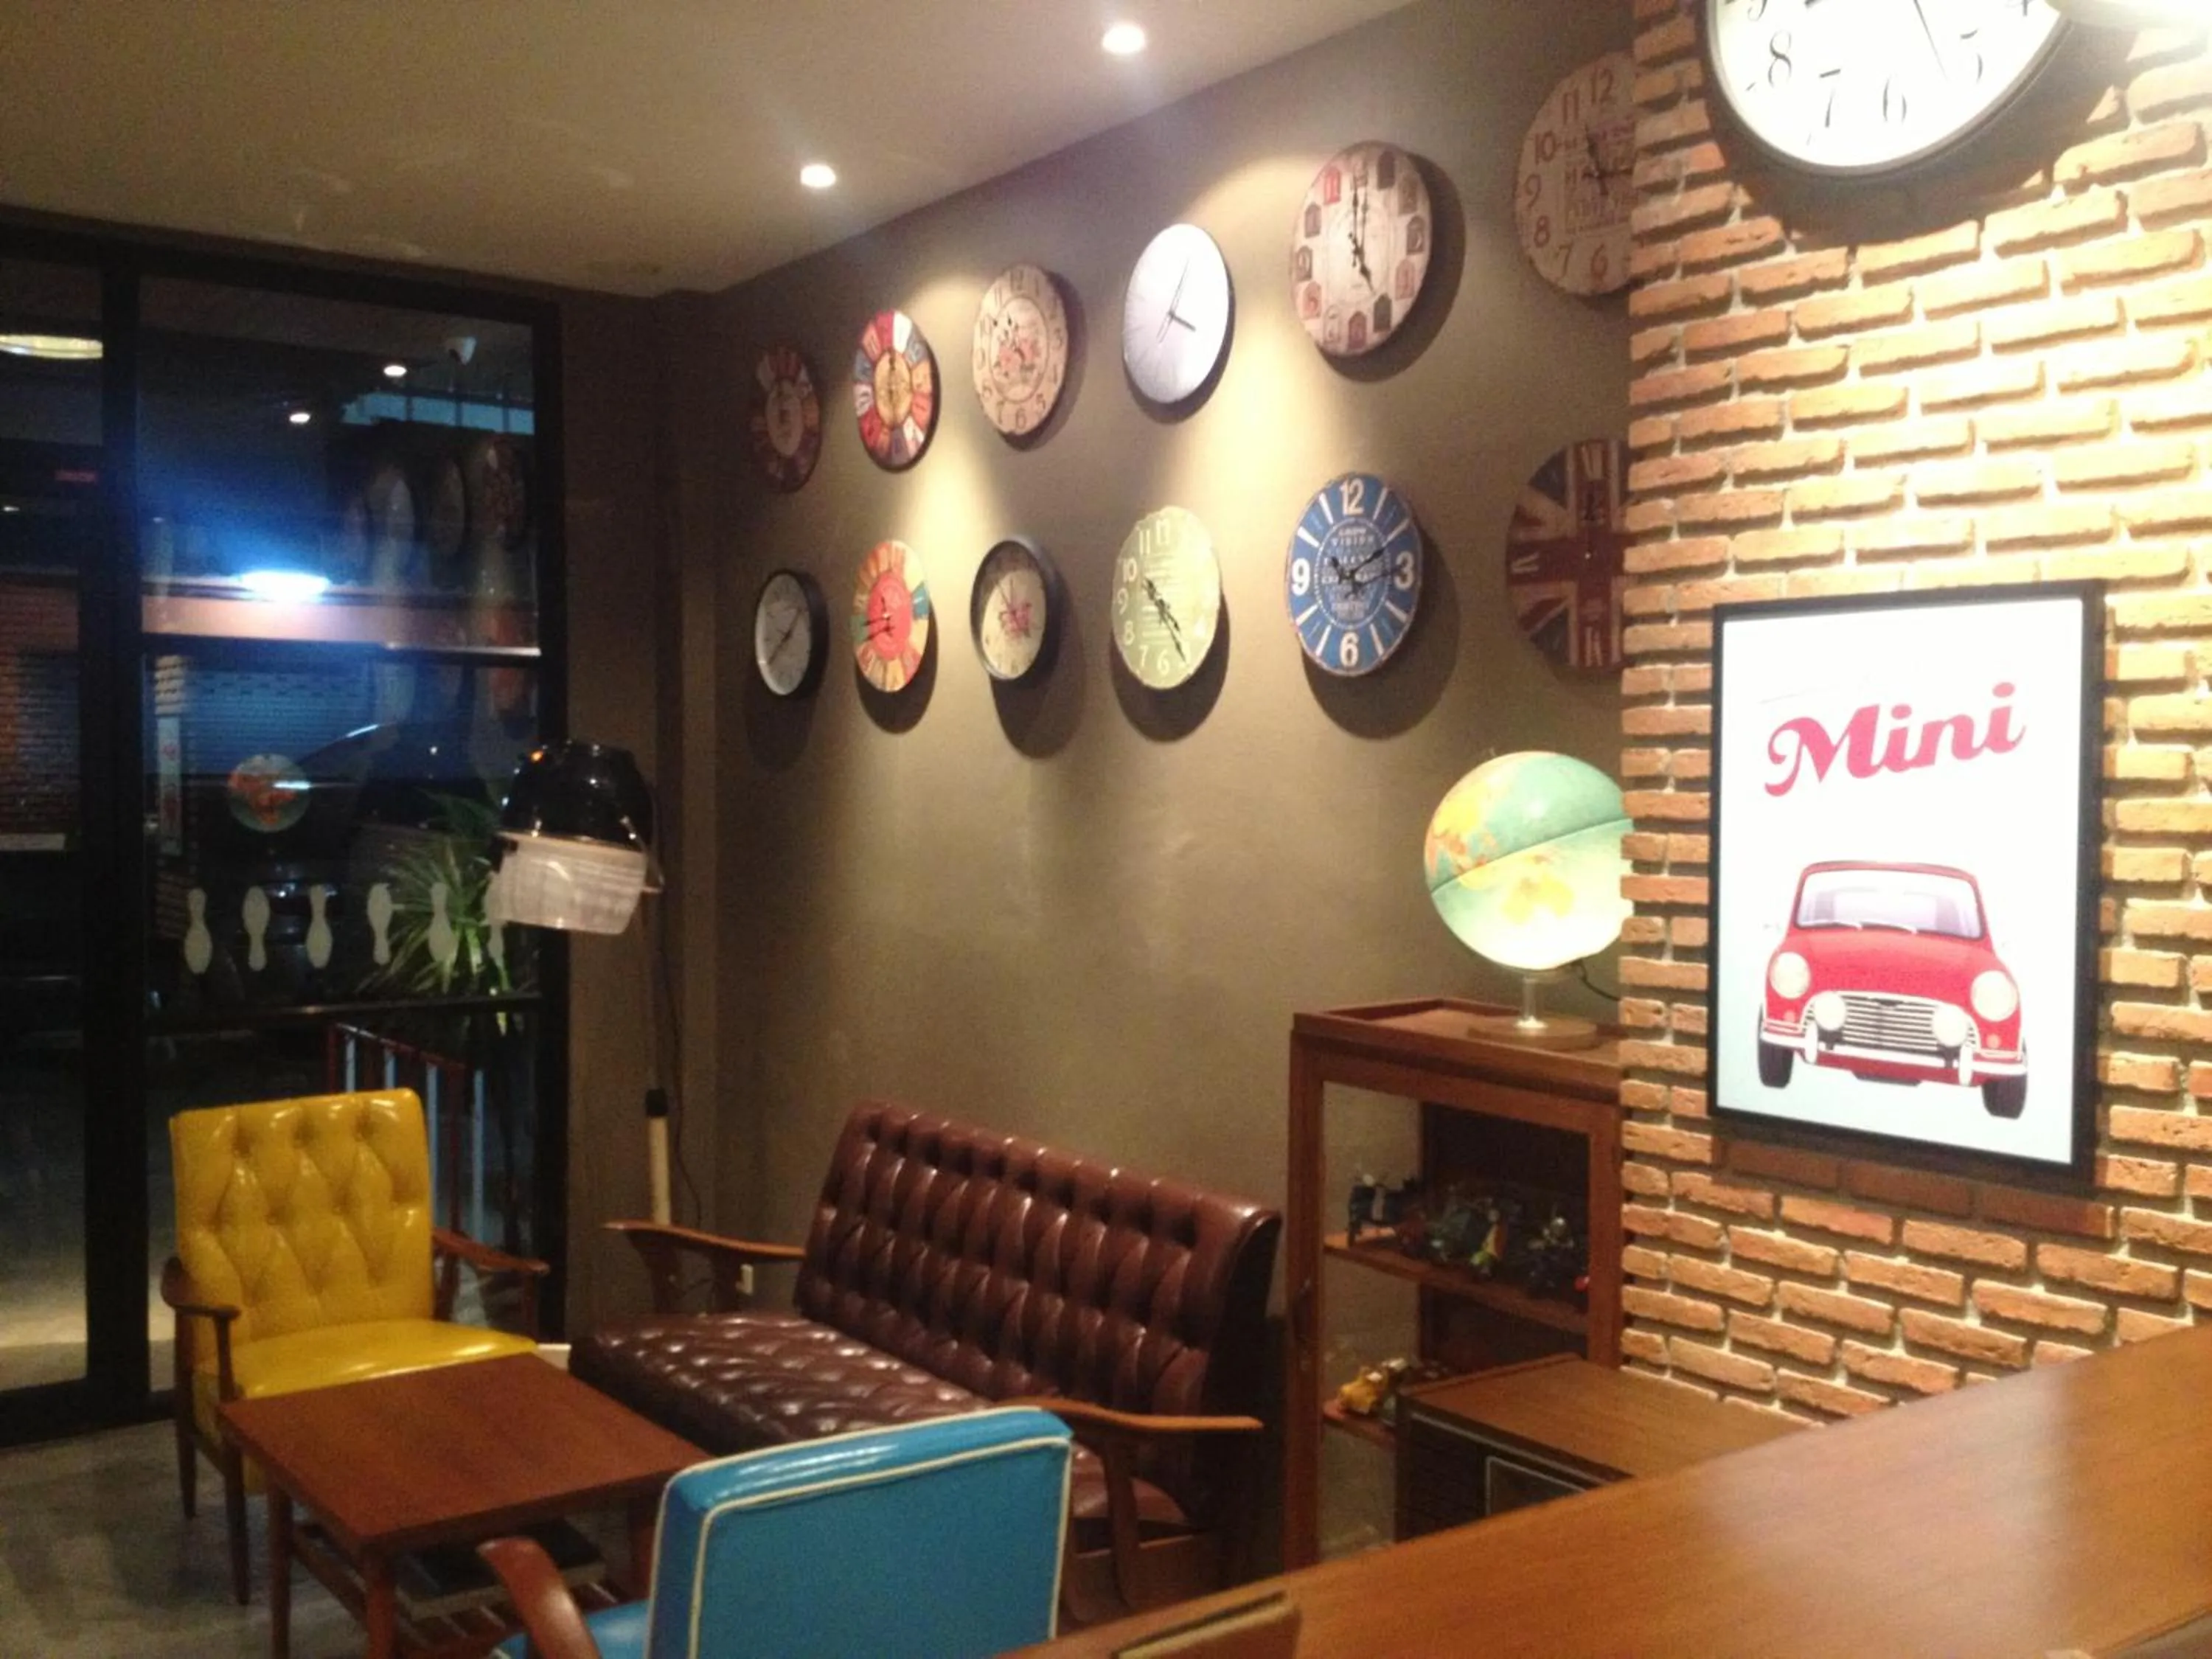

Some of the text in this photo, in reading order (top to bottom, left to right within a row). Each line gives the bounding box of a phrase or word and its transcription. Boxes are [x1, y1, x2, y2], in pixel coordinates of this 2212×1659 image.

[1767, 29, 1792, 88] 8
[1590, 65, 1614, 105] 12
[1562, 89, 1579, 125] 11
[1534, 130, 1557, 164] 10
[1524, 173, 1542, 209] 9
[1534, 215, 1550, 248] 8
[1557, 242, 1573, 277] 7
[1590, 243, 1608, 281] 6
[1340, 478, 1365, 516] 12
[1138, 529, 1151, 554] 11
[1122, 557, 1138, 583] 10
[1291, 557, 1311, 597] 9
[1394, 550, 1414, 590] 3
[1117, 587, 1129, 615] 9
[1124, 619, 1135, 647] 8
[1340, 631, 1359, 667] 6
[1139, 644, 1150, 667] 7
[1156, 648, 1170, 677] 6
[1764, 681, 2027, 797] Mini
